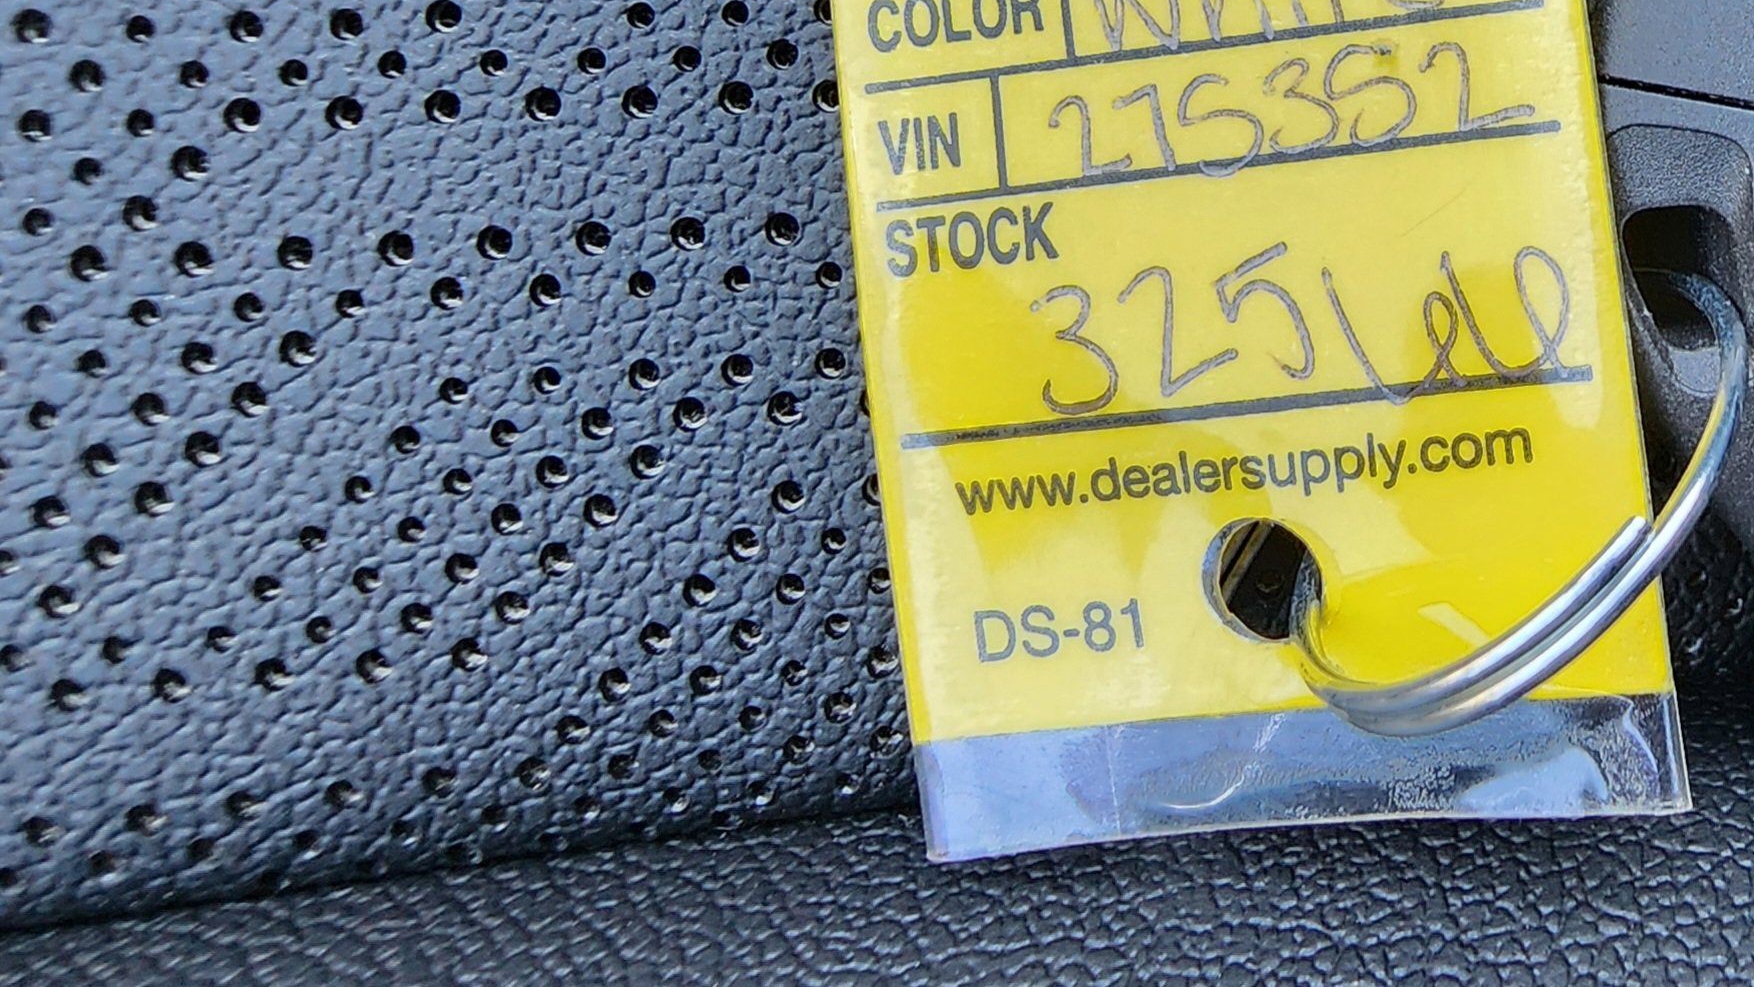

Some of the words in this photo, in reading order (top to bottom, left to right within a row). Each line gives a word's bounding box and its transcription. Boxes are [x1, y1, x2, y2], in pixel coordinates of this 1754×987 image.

[876, 111, 962, 178] VIN
[1046, 39, 1537, 178] 275352
[885, 200, 1061, 278] STOCK
[955, 424, 1533, 517] www.dealersupply.com
[973, 597, 1147, 666] DS-81
